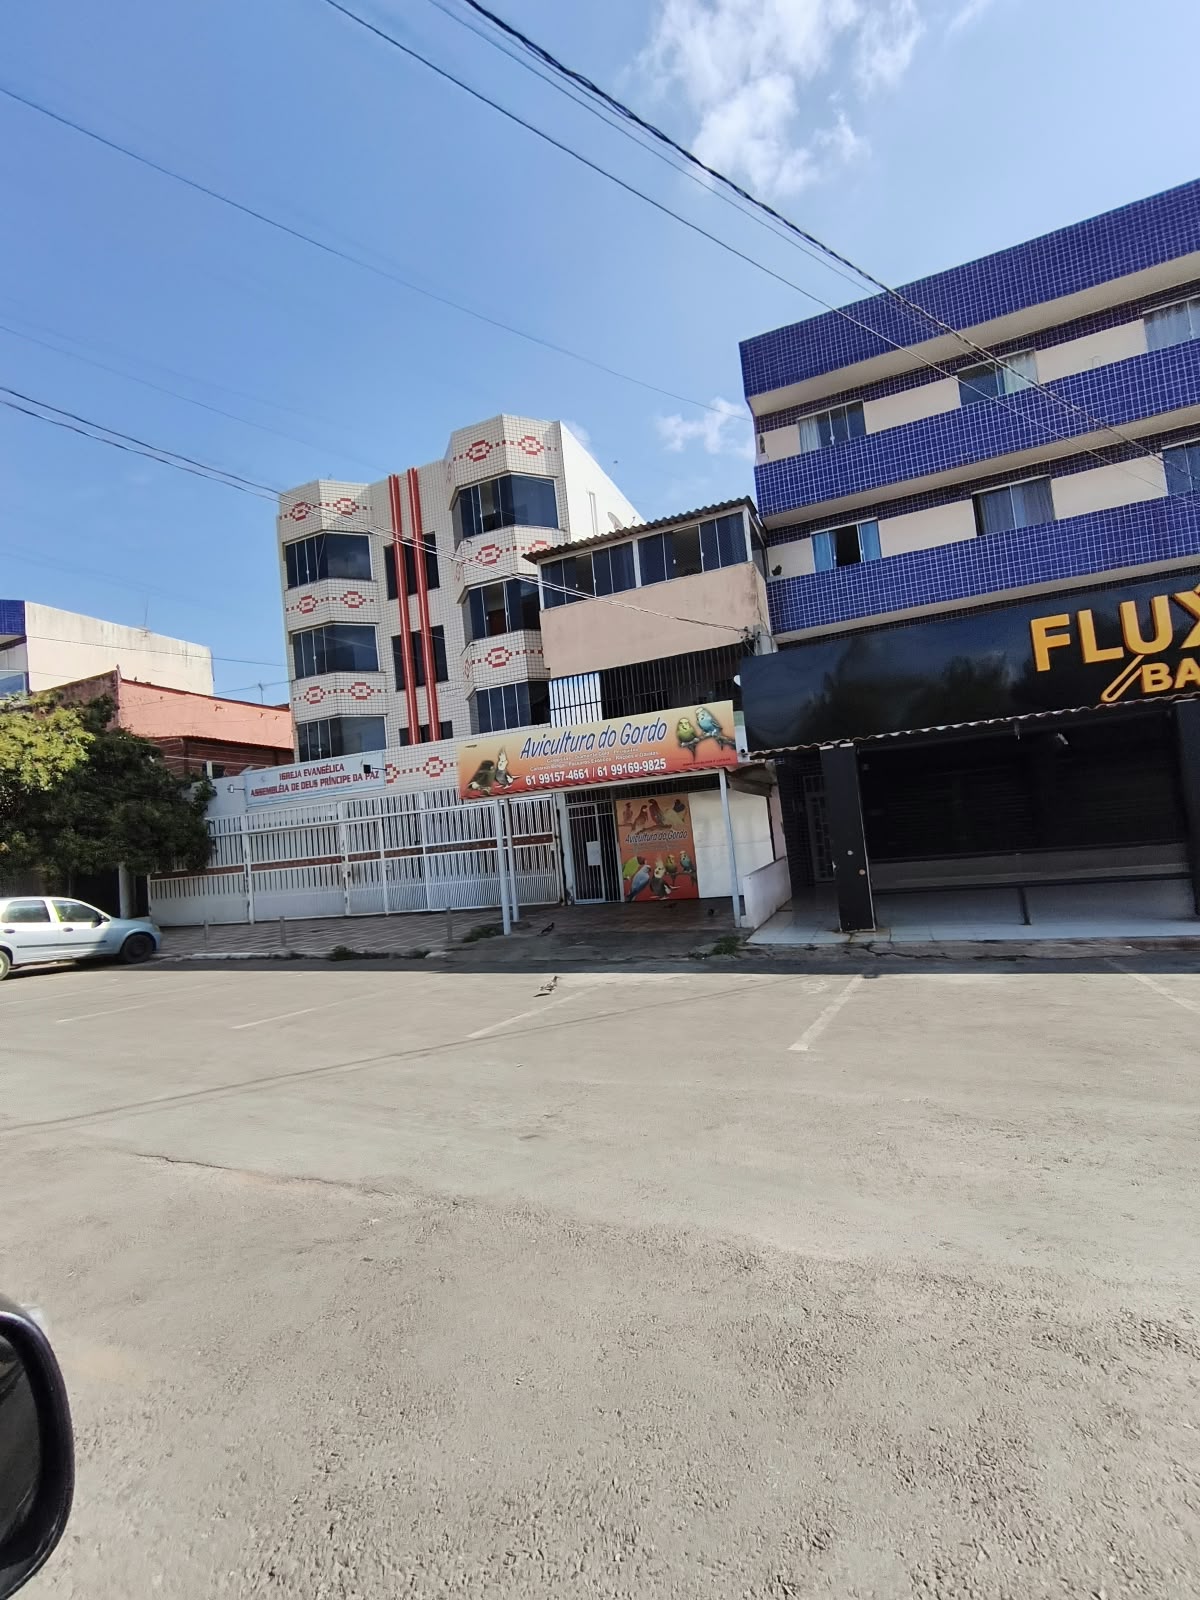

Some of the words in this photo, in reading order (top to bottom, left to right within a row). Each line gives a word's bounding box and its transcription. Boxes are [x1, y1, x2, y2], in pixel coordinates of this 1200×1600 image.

[520, 731, 596, 759] Avicultura
[598, 725, 617, 749] do
[620, 717, 668, 746] Gordo
[251, 783, 290, 797] ASSEMBLÉIA
[291, 780, 300, 792] DE
[300, 779, 319, 789] DEUS
[320, 775, 351, 786] PRÍNCIPE
[353, 772, 364, 782] DA
[365, 770, 380, 781] PAZ
[279, 770, 302, 781] IGREJA
[303, 763, 345, 777] EVANGÉLICA
[525, 774, 536, 786] 61
[538, 767, 590, 785] 99157-4661
[597, 765, 608, 777] 61
[610, 758, 667, 776] 99169-9825
[625, 832, 657, 844] Avicultura
[657, 831, 667, 841] do
[667, 829, 688, 841] Gordo
